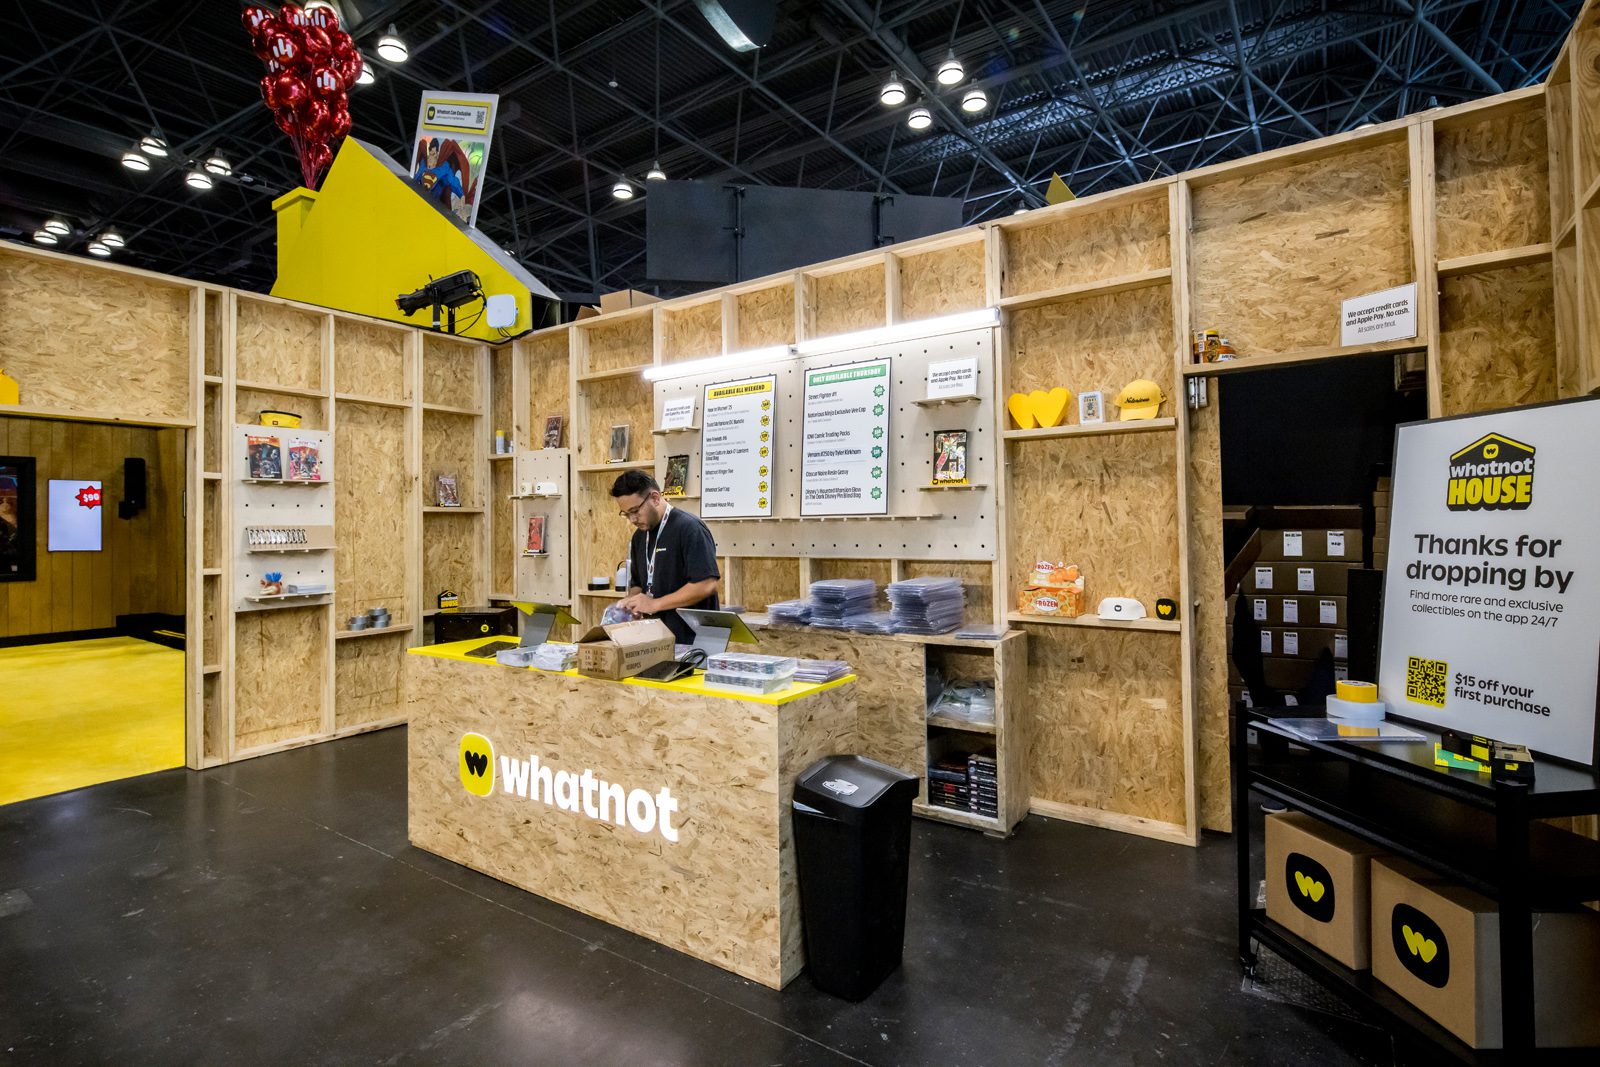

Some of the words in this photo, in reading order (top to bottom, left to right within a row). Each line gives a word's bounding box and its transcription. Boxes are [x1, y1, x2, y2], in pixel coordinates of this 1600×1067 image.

[1357, 307, 1374, 316] accept
[1376, 303, 1391, 312] credit
[1393, 300, 1408, 308] cards
[1357, 316, 1373, 324] Apple
[1395, 308, 1410, 316] cash.
[825, 372, 853, 381] AVAILABLE
[714, 388, 735, 396] AVAILABLE
[1451, 458, 1533, 478] whatnot
[1448, 475, 1532, 505] HOUSE
[1415, 534, 1508, 557] Thanks
[1516, 535, 1562, 558] for
[1406, 560, 1526, 591] dropping
[1535, 566, 1574, 594] by
[1410, 590, 1429, 600] Find
[1432, 592, 1458, 603] more
[1460, 595, 1482, 604] rare
[1484, 598, 1505, 607] and
[1508, 599, 1563, 613] exclusive
[1412, 603, 1465, 618] collectibles
[1467, 610, 1481, 619] on
[1484, 610, 1502, 621] the
[1504, 615, 1528, 625] app
[1531, 615, 1558, 628] 24/7
[1455, 672, 1475, 687] $15
[1478, 680, 1499, 692] off
[1501, 684, 1534, 698] your
[1454, 687, 1481, 702] first
[1484, 694, 1550, 716] purchase
[500, 755, 678, 842] whatnot
